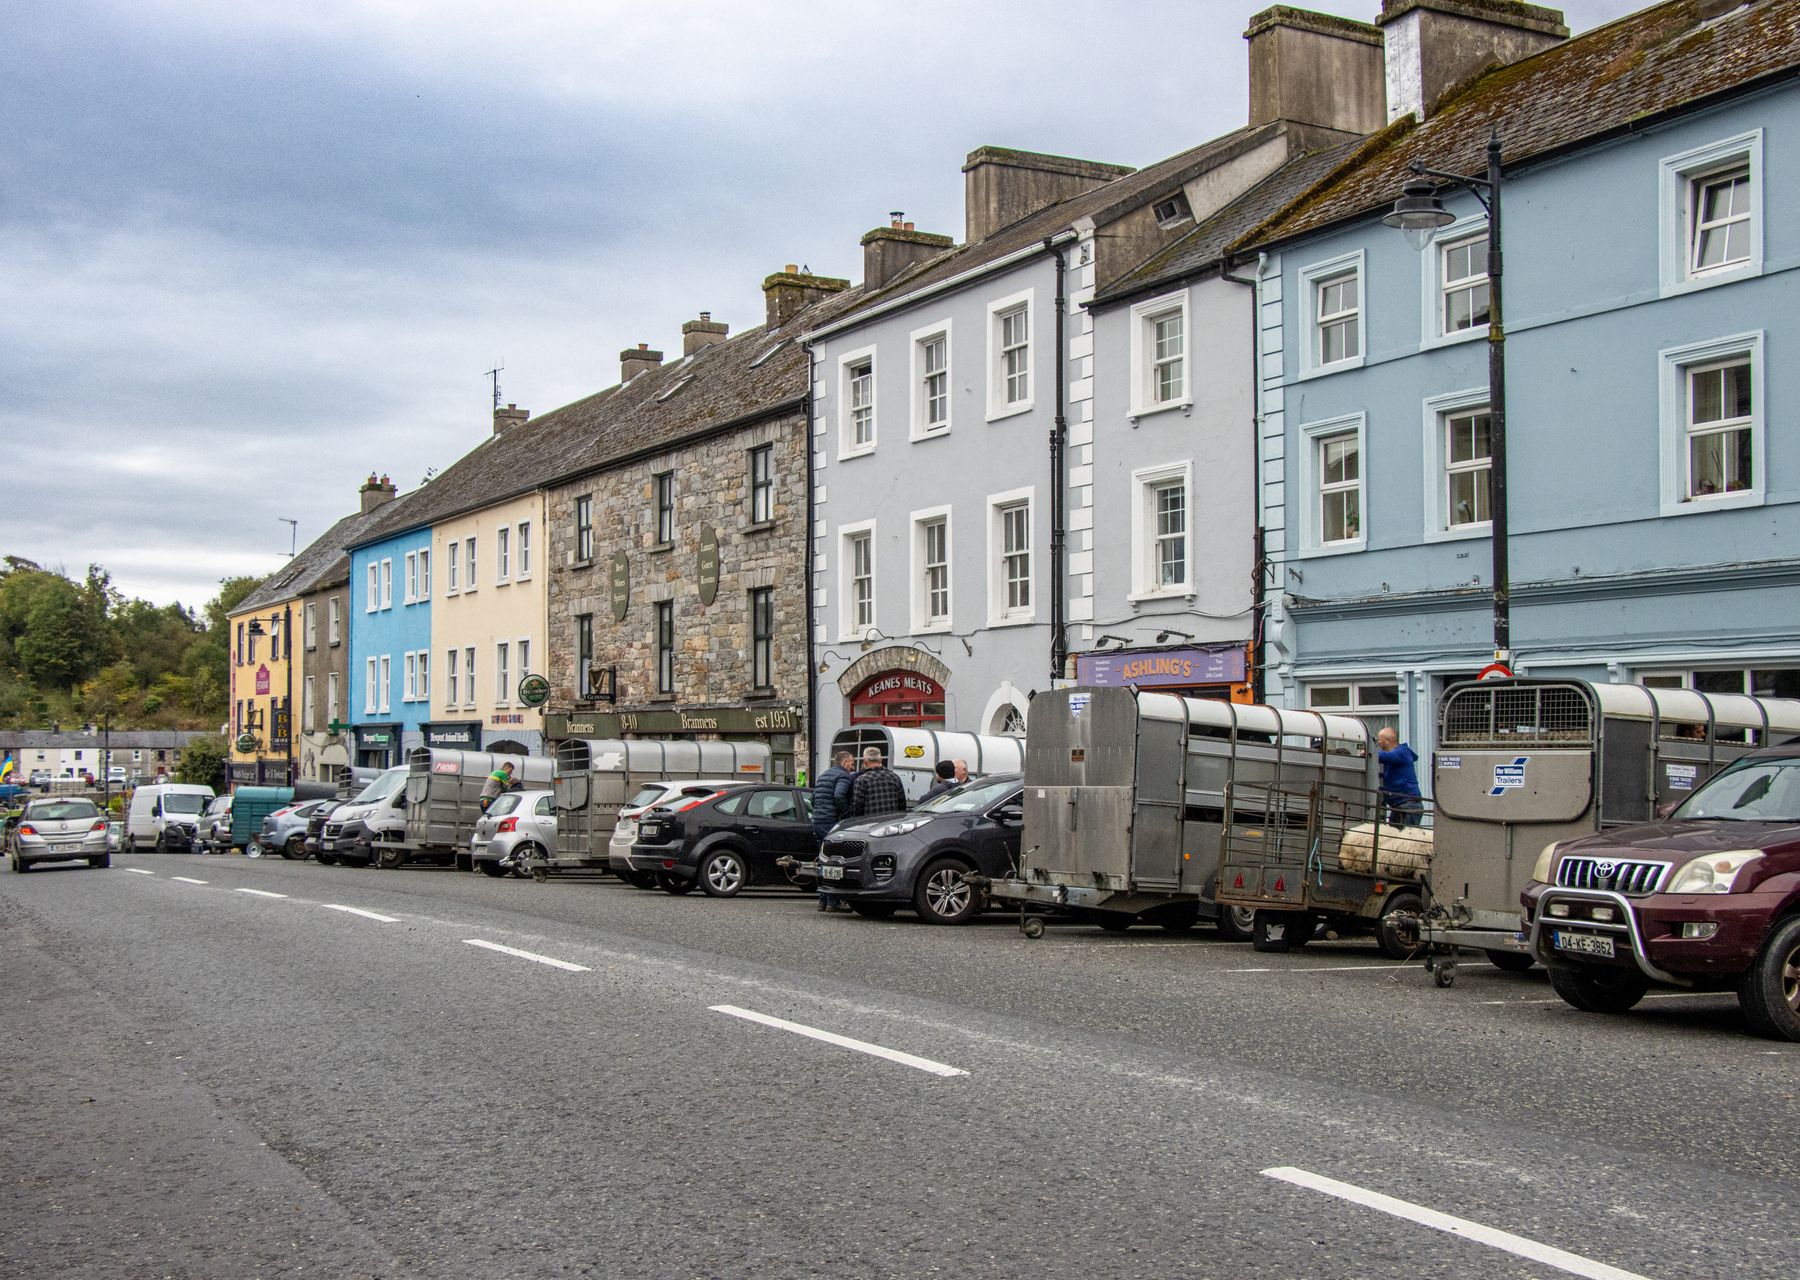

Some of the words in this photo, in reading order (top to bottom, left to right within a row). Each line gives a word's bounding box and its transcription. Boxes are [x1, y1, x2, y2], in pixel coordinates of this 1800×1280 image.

[701, 560, 713, 569] Guest
[614, 578, 626, 587] Wines
[700, 575, 715, 585] Rooms
[1122, 657, 1192, 681] ASHLING'S
[868, 677, 900, 698] KEANES
[904, 677, 933, 695] MEATS
[566, 719, 595, 734] Brannens
[621, 714, 638, 730] 8-10
[681, 712, 718, 729] Brannens
[755, 714, 768, 728] est
[770, 710, 791, 728] 1951
[1496, 776, 1522, 784] Trailers
